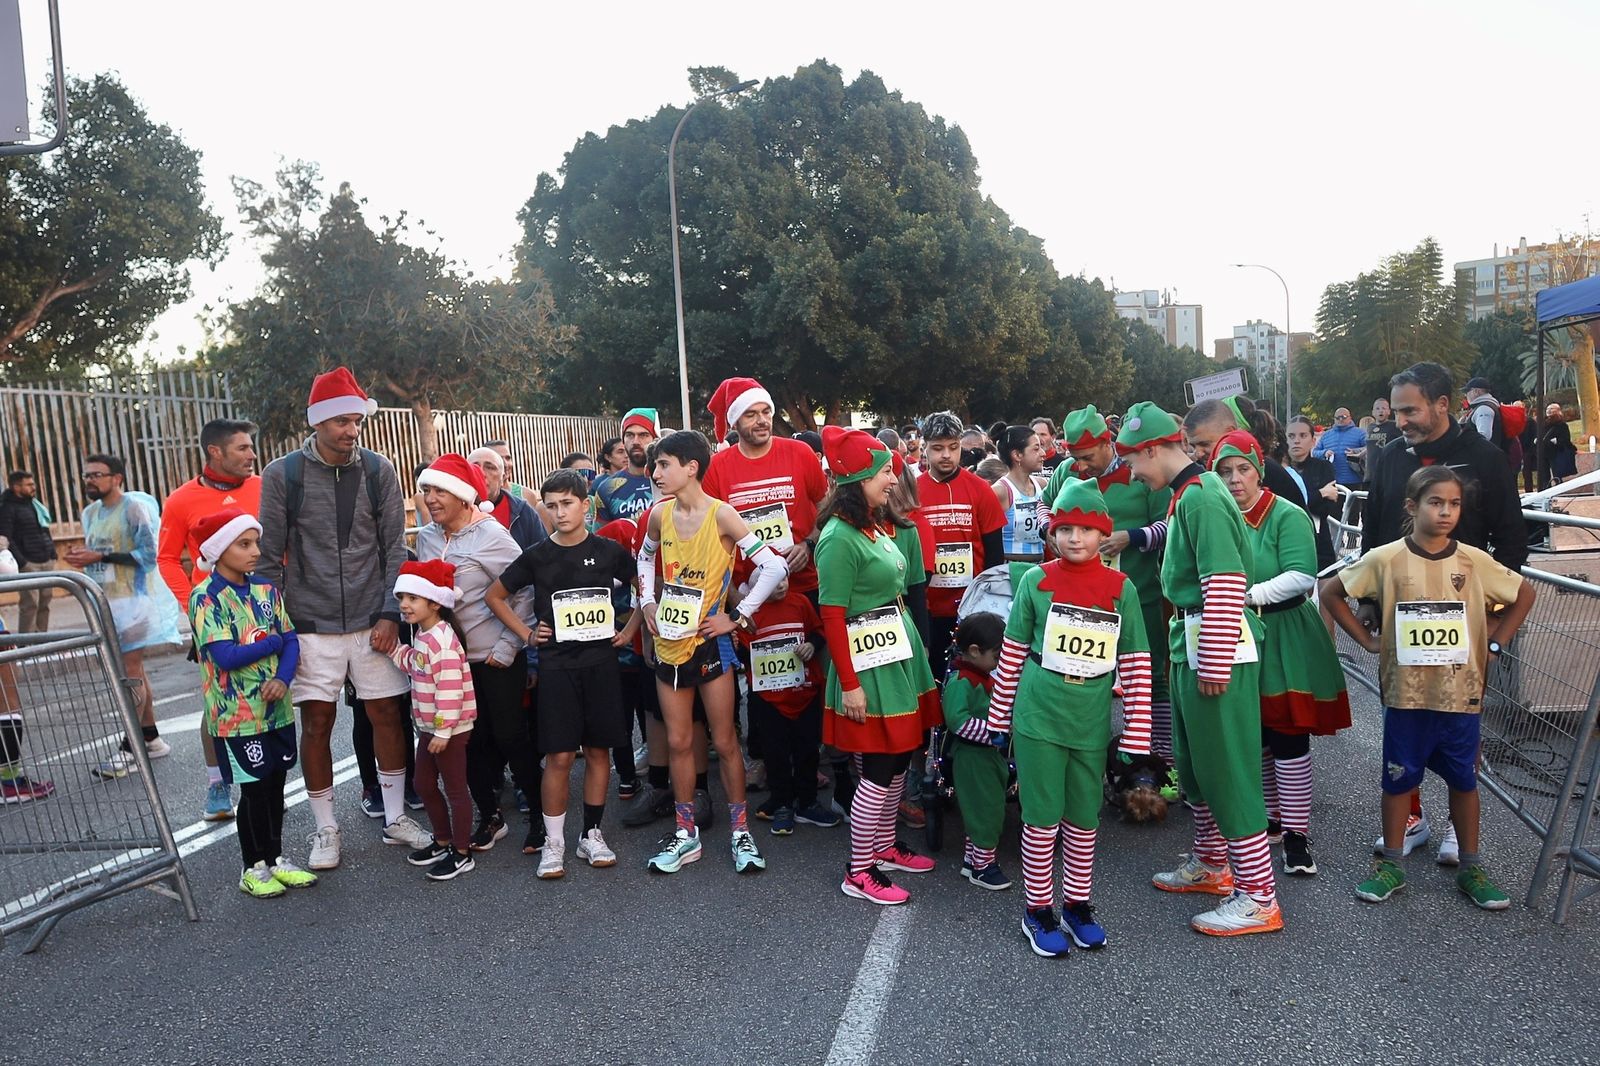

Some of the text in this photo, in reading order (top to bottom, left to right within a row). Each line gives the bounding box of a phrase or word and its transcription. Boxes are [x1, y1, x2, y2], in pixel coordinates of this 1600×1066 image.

[1195, 383, 1241, 399] NO FEDERADOS
[754, 524, 783, 542] 023
[565, 609, 606, 628] 1040
[660, 606, 690, 626] 1025
[853, 631, 897, 654] 1009
[1055, 634, 1106, 660] 1021
[1409, 628, 1459, 647] 1020
[760, 658, 797, 676] 1024
